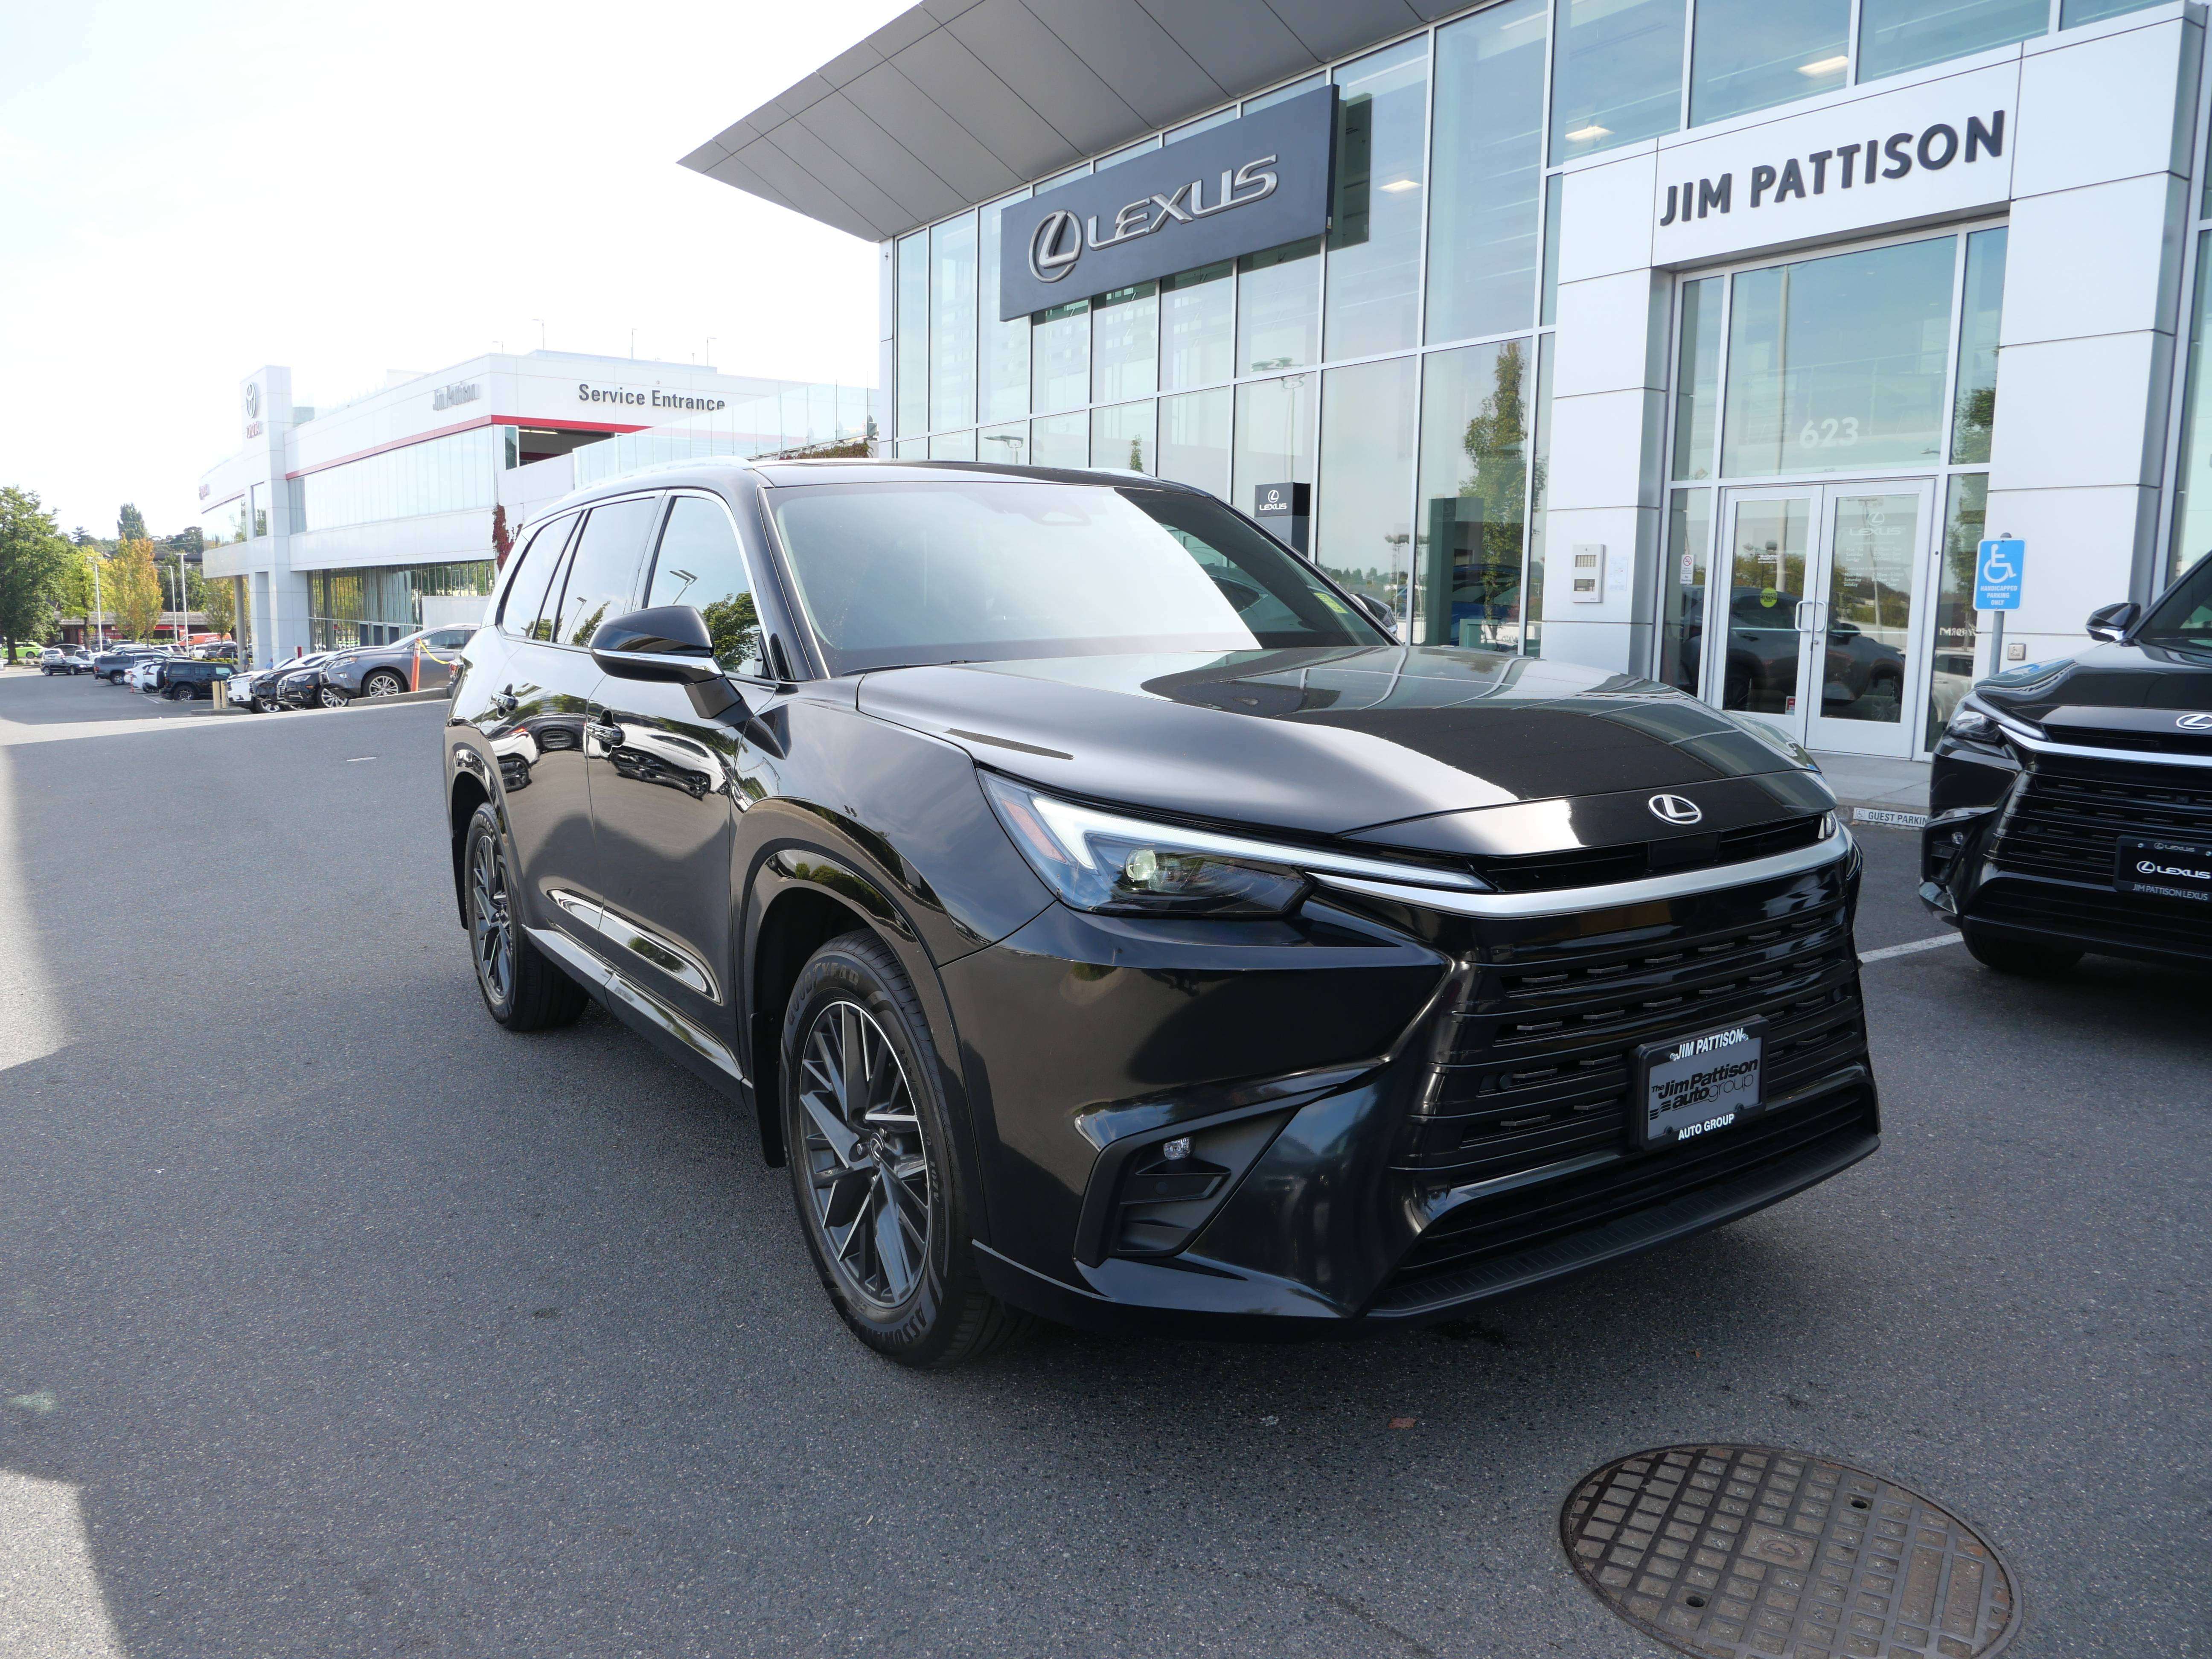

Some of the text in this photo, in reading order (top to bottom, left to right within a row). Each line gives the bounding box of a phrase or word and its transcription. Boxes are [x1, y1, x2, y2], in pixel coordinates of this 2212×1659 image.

[1660, 110, 2005, 226] JIM PATTISON
[1088, 154, 1278, 251] LEXUS
[433, 390, 446, 411] Jim
[579, 384, 725, 411] Service Entrance
[246, 421, 260, 439] TOYOTA
[1799, 417, 1859, 448] 623
[1849, 527, 1901, 536] LEXUS
[1869, 812, 1927, 825] GUEST PARKIN
[2157, 866, 2211, 879] LEXUS
[2133, 884, 2208, 900] JIM PATTISON LEXUS
[787, 962, 859, 1026] GOODYEAR
[1676, 1028, 1743, 1059] JIM PATTISON
[1652, 1059, 1758, 1099] The Jim Pattison
[1678, 1113, 1735, 1141] AUTO GROUP
